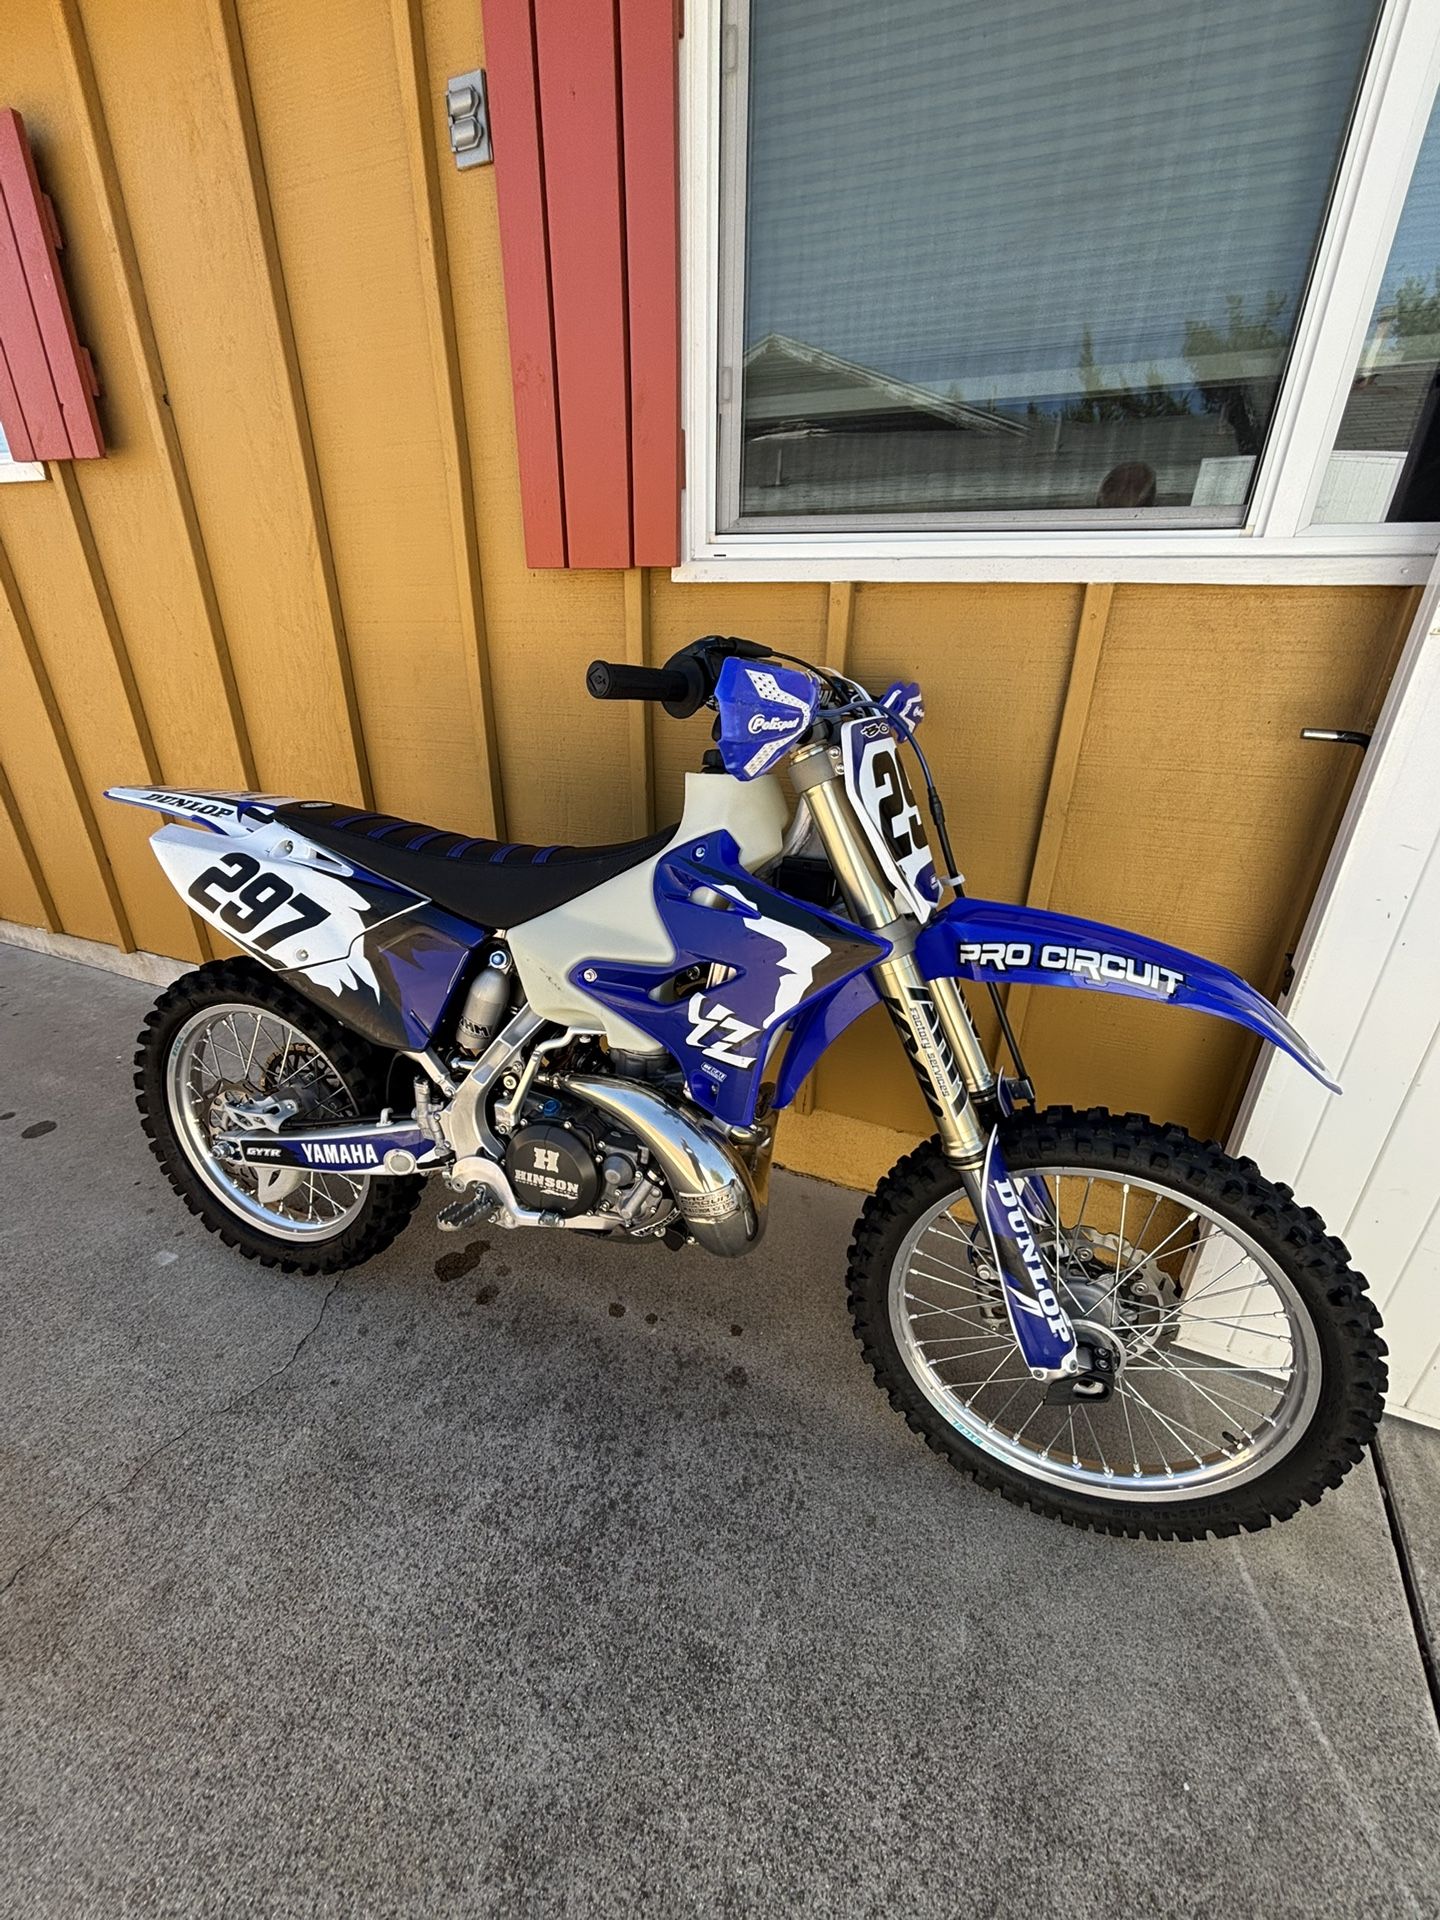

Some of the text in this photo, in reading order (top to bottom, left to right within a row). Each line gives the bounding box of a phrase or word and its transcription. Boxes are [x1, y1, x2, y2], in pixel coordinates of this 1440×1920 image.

[748, 714, 799, 734] Polisport
[143, 793, 234, 819] DUNLOP
[188, 852, 332, 951] 297
[960, 943, 1183, 993] PRO CIRCUIT
[685, 992, 761, 1068] YZ
[246, 1148, 282, 1158] GYTR
[301, 1143, 379, 1164] YAMAHA
[533, 1147, 560, 1173] H
[514, 1169, 579, 1193] HINSON
[994, 1178, 1071, 1342] DUNLOP
